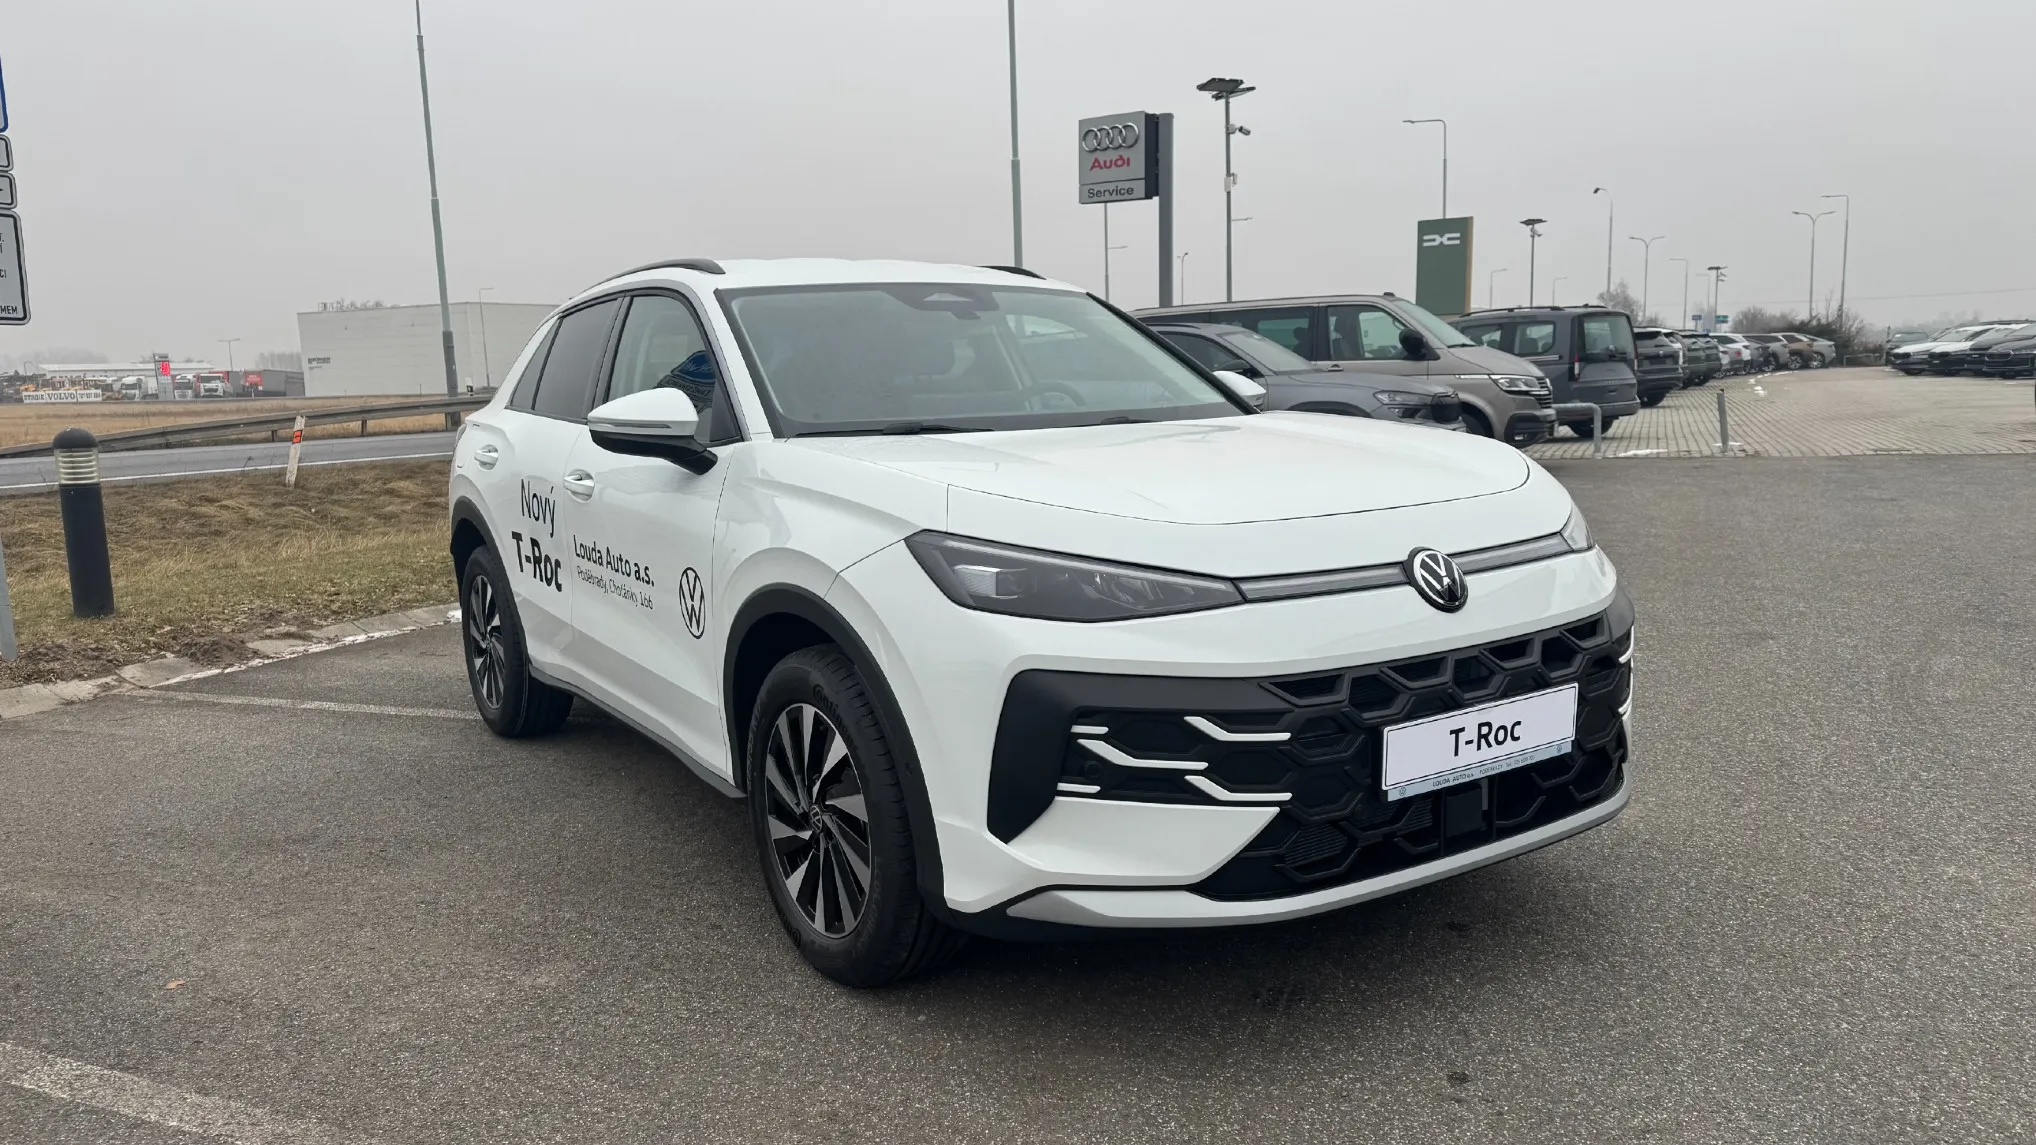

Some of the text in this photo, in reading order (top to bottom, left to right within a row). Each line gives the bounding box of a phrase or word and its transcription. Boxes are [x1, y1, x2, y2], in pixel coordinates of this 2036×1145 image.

[1089, 154, 1131, 171] Audi
[1087, 185, 1134, 198] Service
[0, 305, 18, 315] MEM
[47, 391, 76, 400] VOLVO
[521, 478, 556, 538] Nový
[511, 530, 563, 593] T-Roc
[573, 534, 655, 587] Louda Auto a.s.
[639, 590, 654, 610] 166
[1449, 720, 1523, 758] T-Roc
